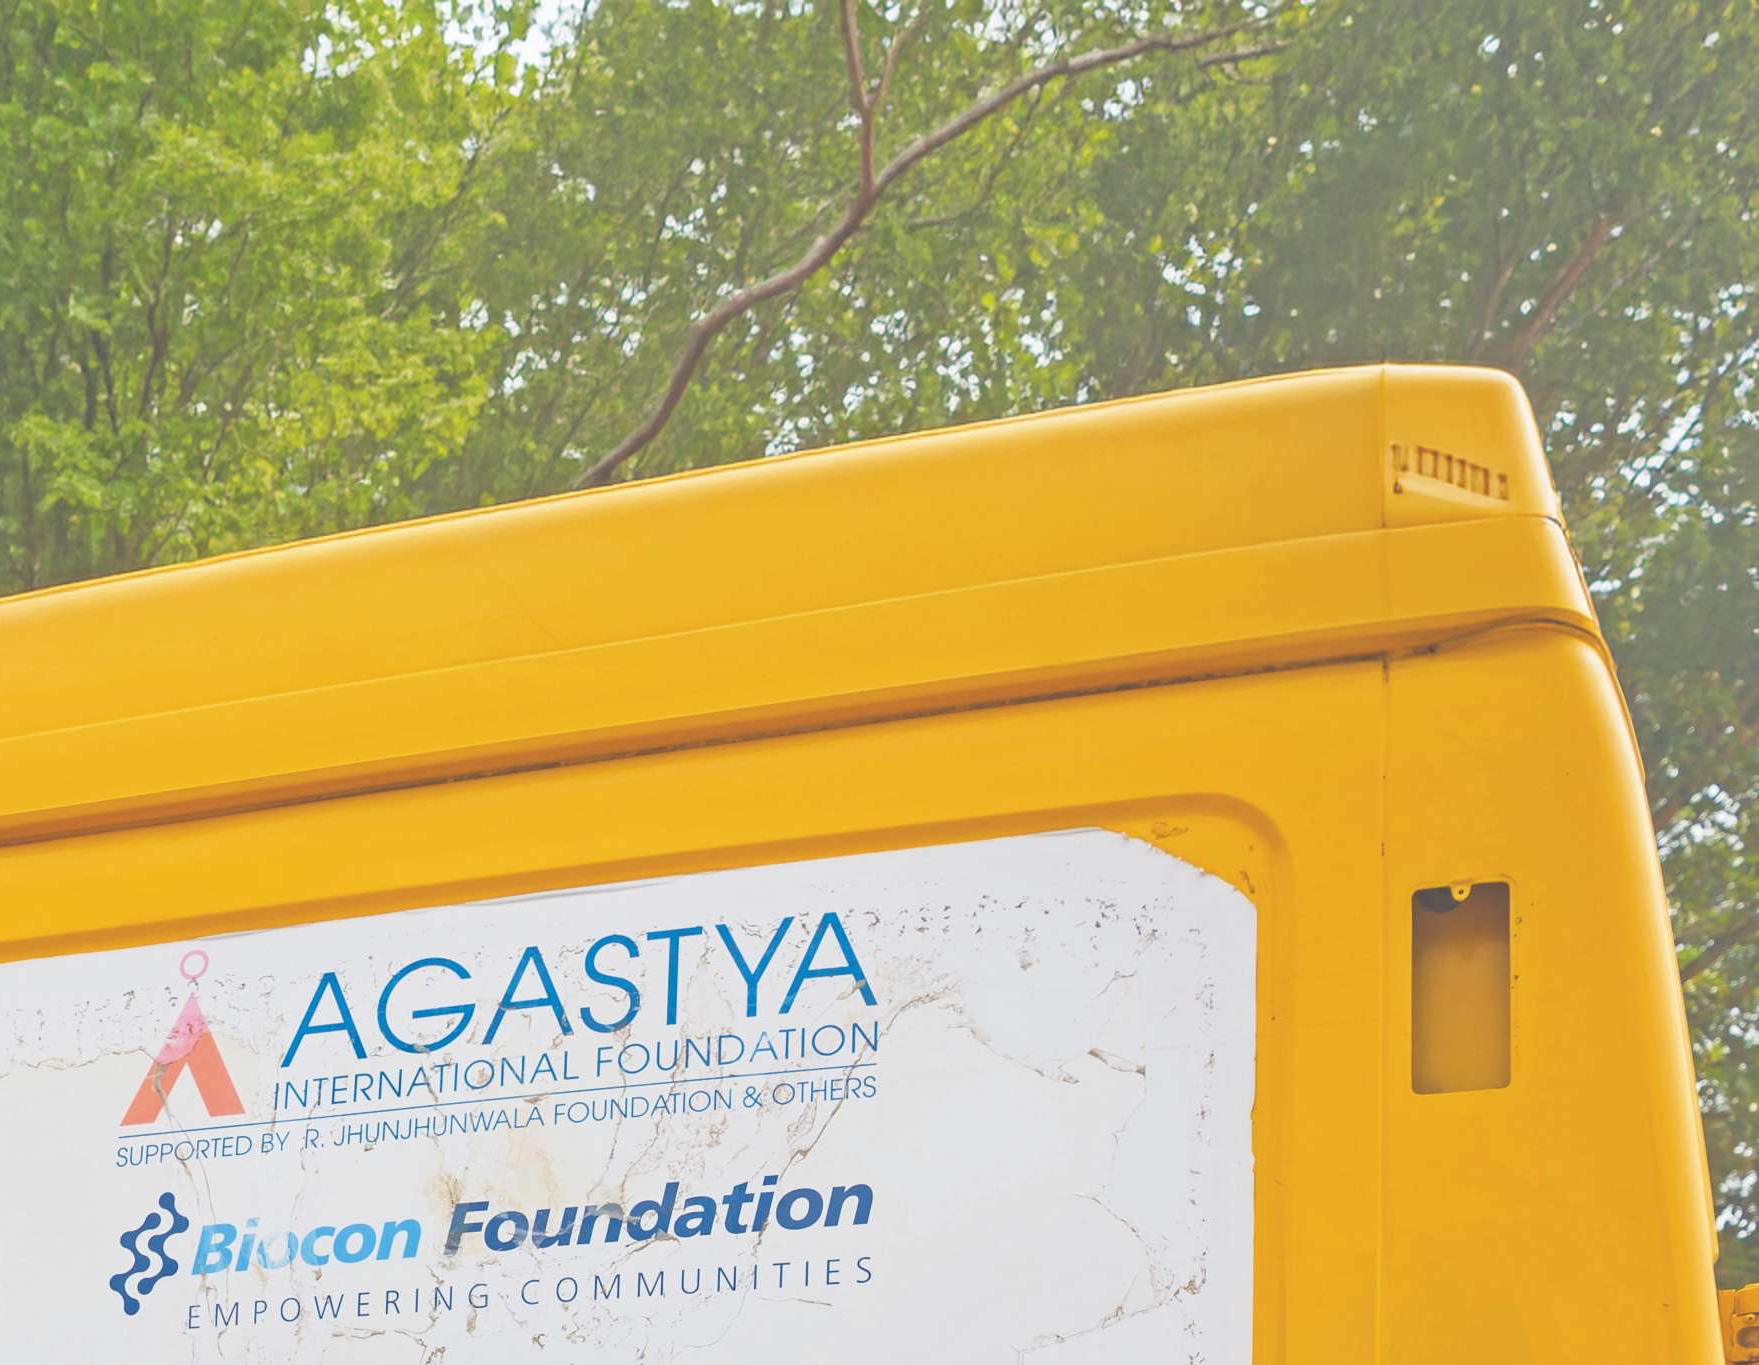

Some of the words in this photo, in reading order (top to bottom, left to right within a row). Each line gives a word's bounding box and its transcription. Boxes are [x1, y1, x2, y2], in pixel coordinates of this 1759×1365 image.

[281, 912, 878, 1068] AGASTYA
[273, 1050, 579, 1111] INTERNATIONAL
[596, 1020, 879, 1077] FOUNDATION
[115, 1134, 252, 1168] SUPPORTED
[260, 1130, 290, 1154] BY
[304, 1127, 324, 1149] R.
[333, 1105, 544, 1147] JHUNJHUNWALA
[553, 1085, 732, 1126] FOUNDATION
[742, 1084, 762, 1108] &
[772, 1075, 877, 1106] OTHERS
[191, 1216, 422, 1276] Biocon
[442, 1174, 875, 1257] Foundation
[187, 1283, 490, 1330] EMPOWERING
[520, 1256, 873, 1305] COMMUNITIES
